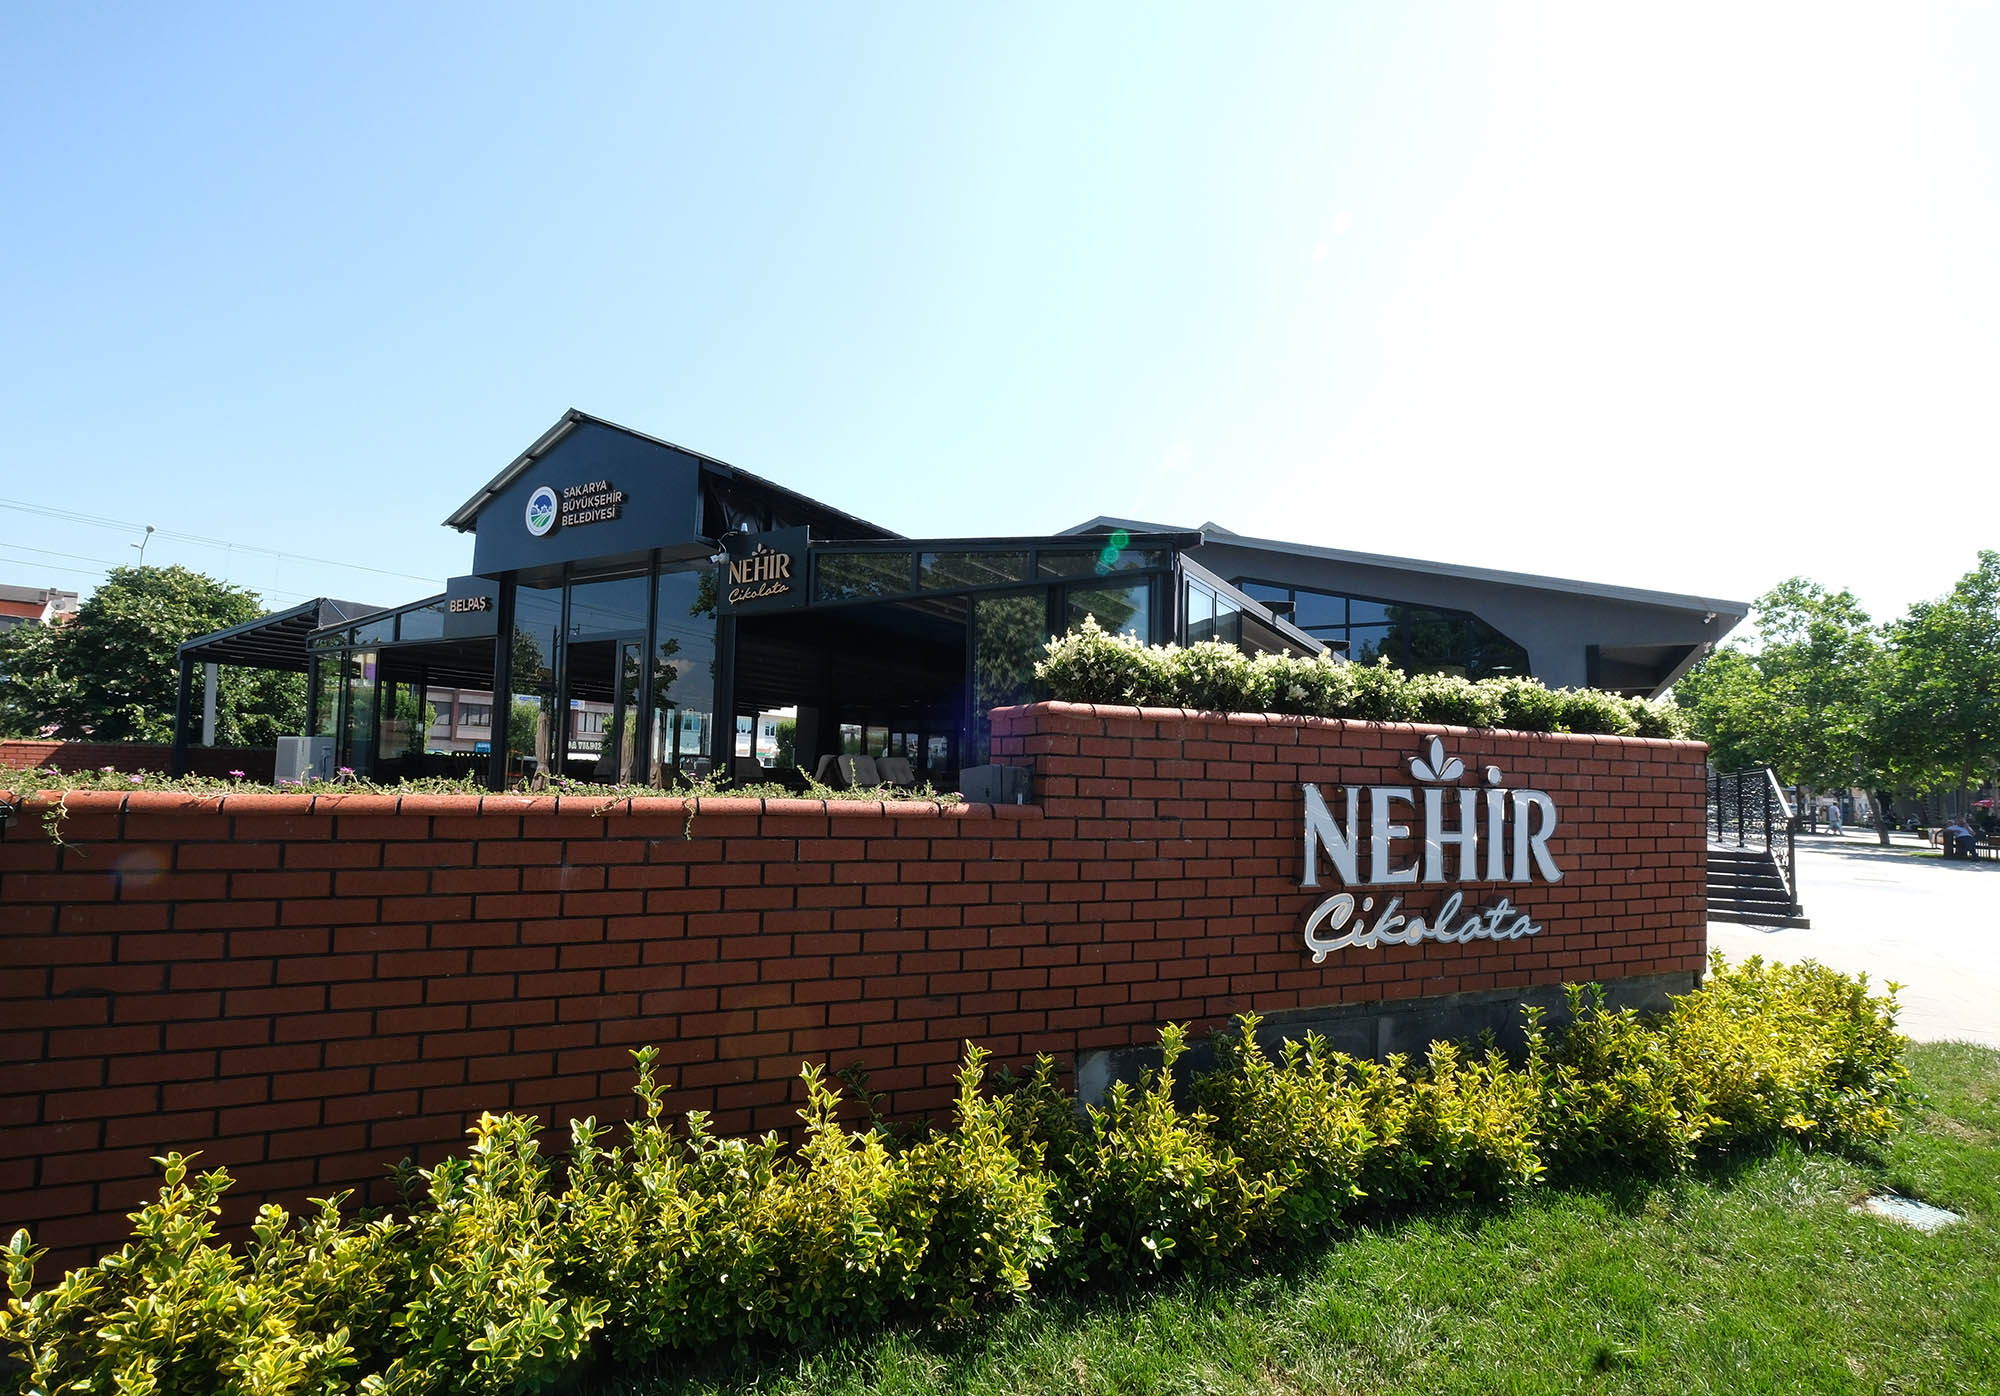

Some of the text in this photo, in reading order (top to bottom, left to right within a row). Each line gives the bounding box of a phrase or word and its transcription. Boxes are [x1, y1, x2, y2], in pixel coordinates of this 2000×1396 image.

[564, 480, 608, 498] SAKARYA
[562, 490, 622, 513] BÜYÜKŞEHİR
[561, 504, 616, 526] BELEDİYESİ
[729, 549, 790, 585] NEHİR
[449, 596, 487, 613] BELPAŞ
[728, 581, 789, 605] Çikolata
[1300, 766, 1565, 887] NEHİR
[1304, 891, 1542, 963] Çikolata
